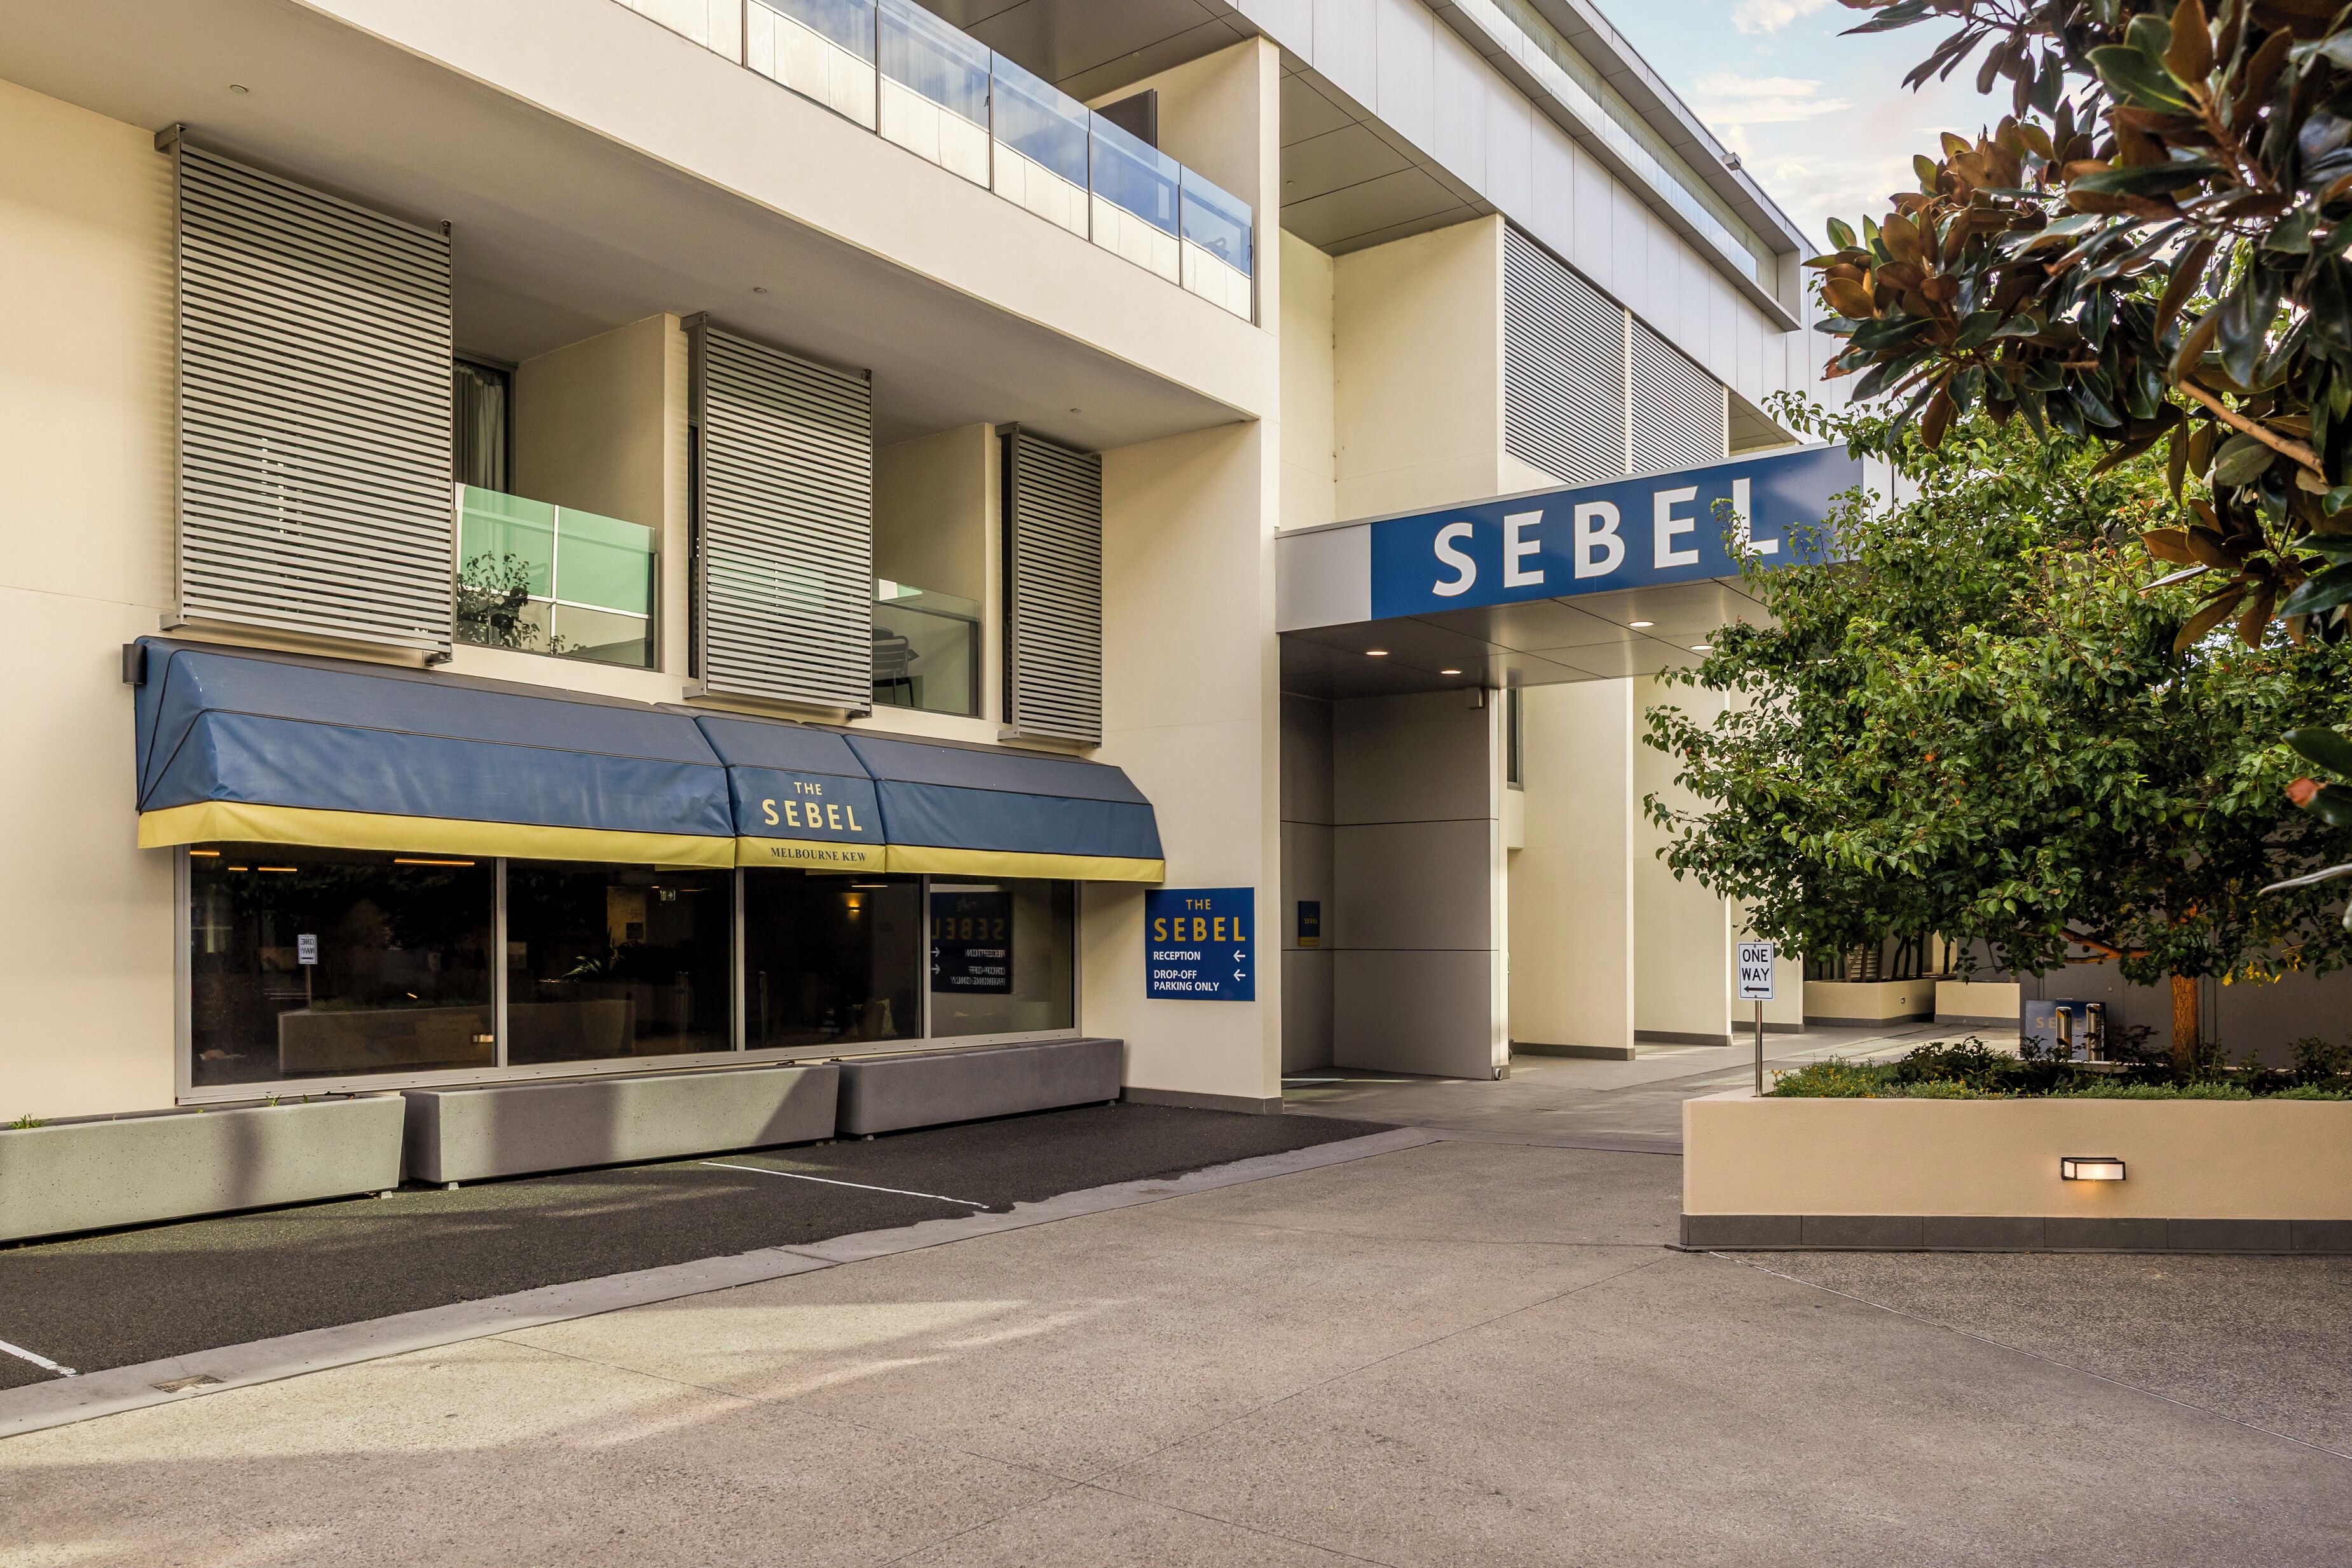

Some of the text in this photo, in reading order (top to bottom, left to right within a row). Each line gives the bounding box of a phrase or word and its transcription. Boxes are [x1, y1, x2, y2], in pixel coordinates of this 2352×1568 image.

[1432, 477, 1779, 596] SEBEL
[794, 782, 822, 795] THE
[762, 798, 863, 831] SEBEL
[770, 847, 866, 862] MELBOURNE KEW
[1186, 899, 1211, 910] THE
[1154, 917, 1246, 942] SEBEL
[1153, 951, 1201, 960] RECEPTION
[1742, 949, 1768, 962] ONE
[1154, 970, 1197, 979] DROP-OFF
[1742, 967, 1770, 981] WAY
[1154, 981, 1219, 992] PARKING ONLY
